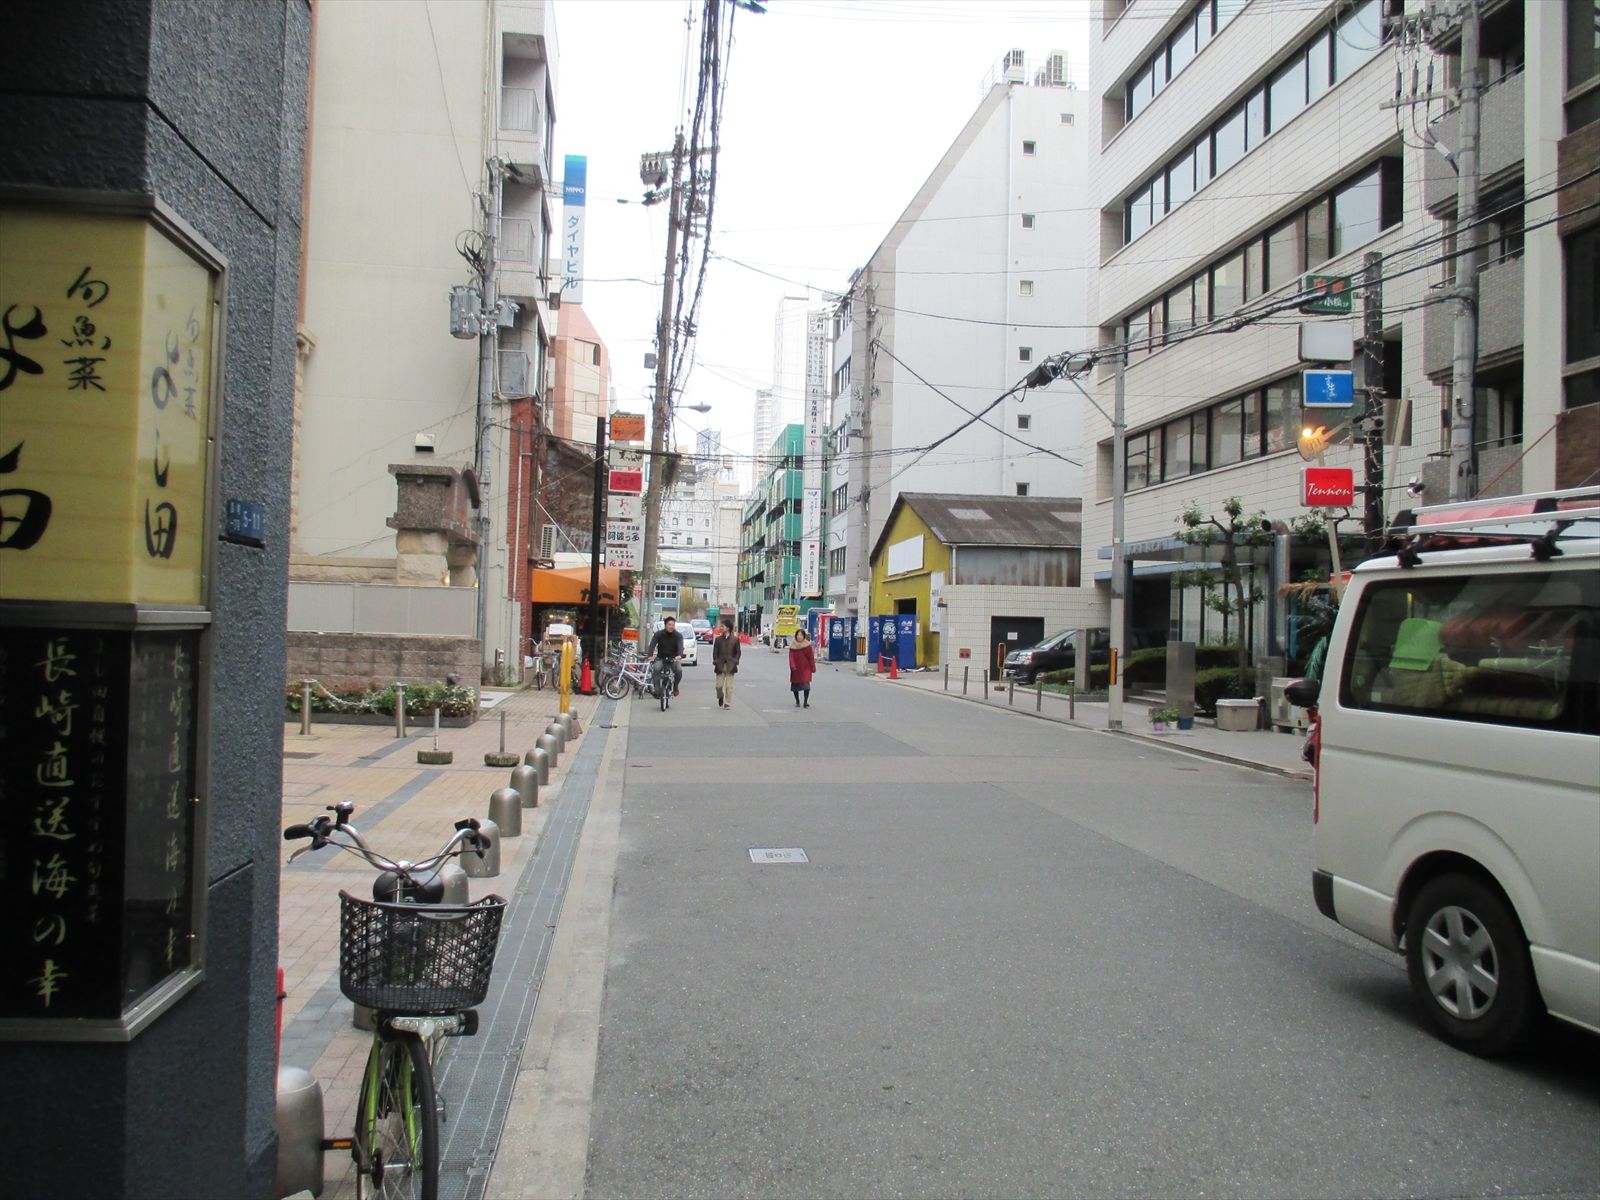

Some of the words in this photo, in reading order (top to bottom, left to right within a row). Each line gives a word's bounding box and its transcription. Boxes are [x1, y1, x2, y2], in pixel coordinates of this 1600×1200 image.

[566, 215, 581, 290] ダイヤビル
[60, 266, 113, 392] 旬魚菜
[1307, 482, 1352, 498] Tension
[28, 637, 79, 1008] 長崎直送海の幸
